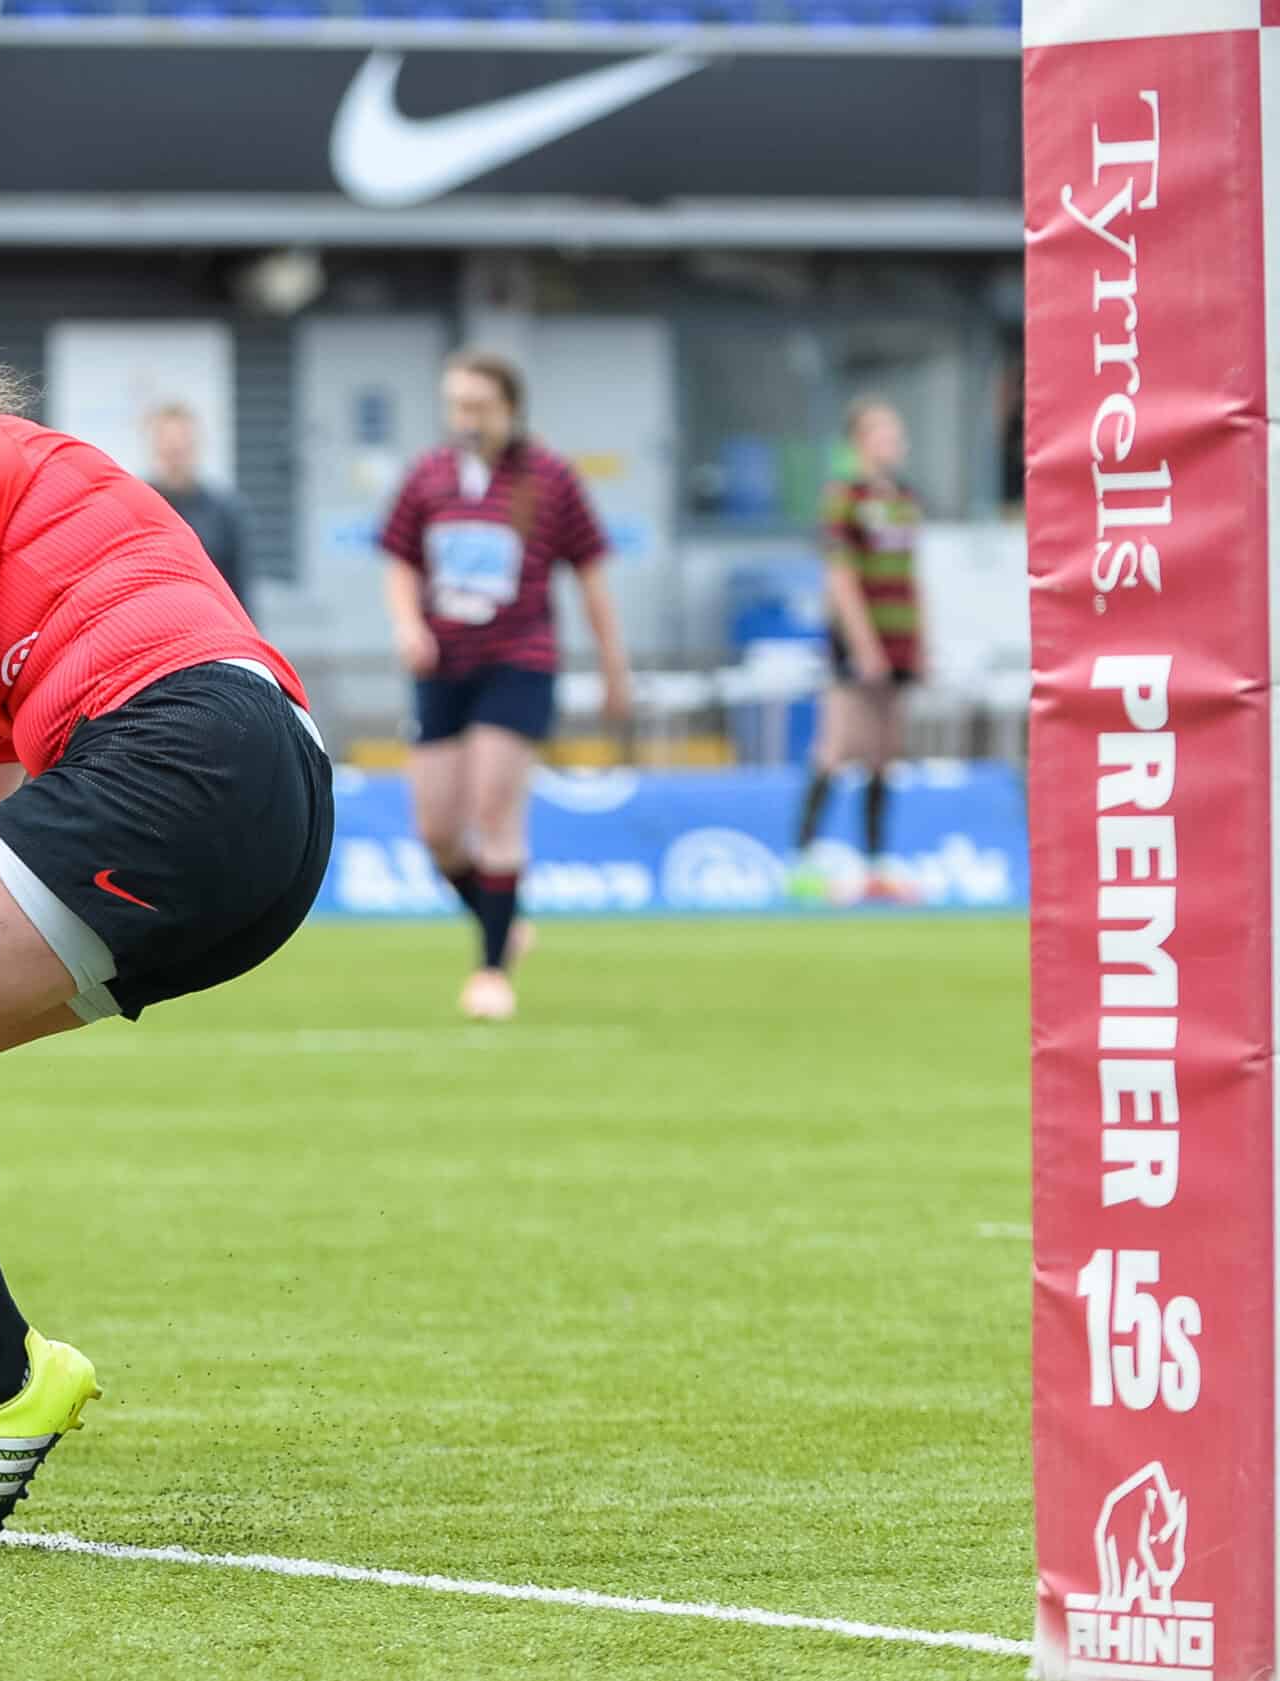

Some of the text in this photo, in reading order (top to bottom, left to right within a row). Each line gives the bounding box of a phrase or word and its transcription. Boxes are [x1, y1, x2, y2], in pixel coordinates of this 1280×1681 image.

[1090, 655, 1180, 1209] PREMIER
[1076, 1248, 1201, 1413] 15s
[1066, 1610, 1215, 1668] RHINO
